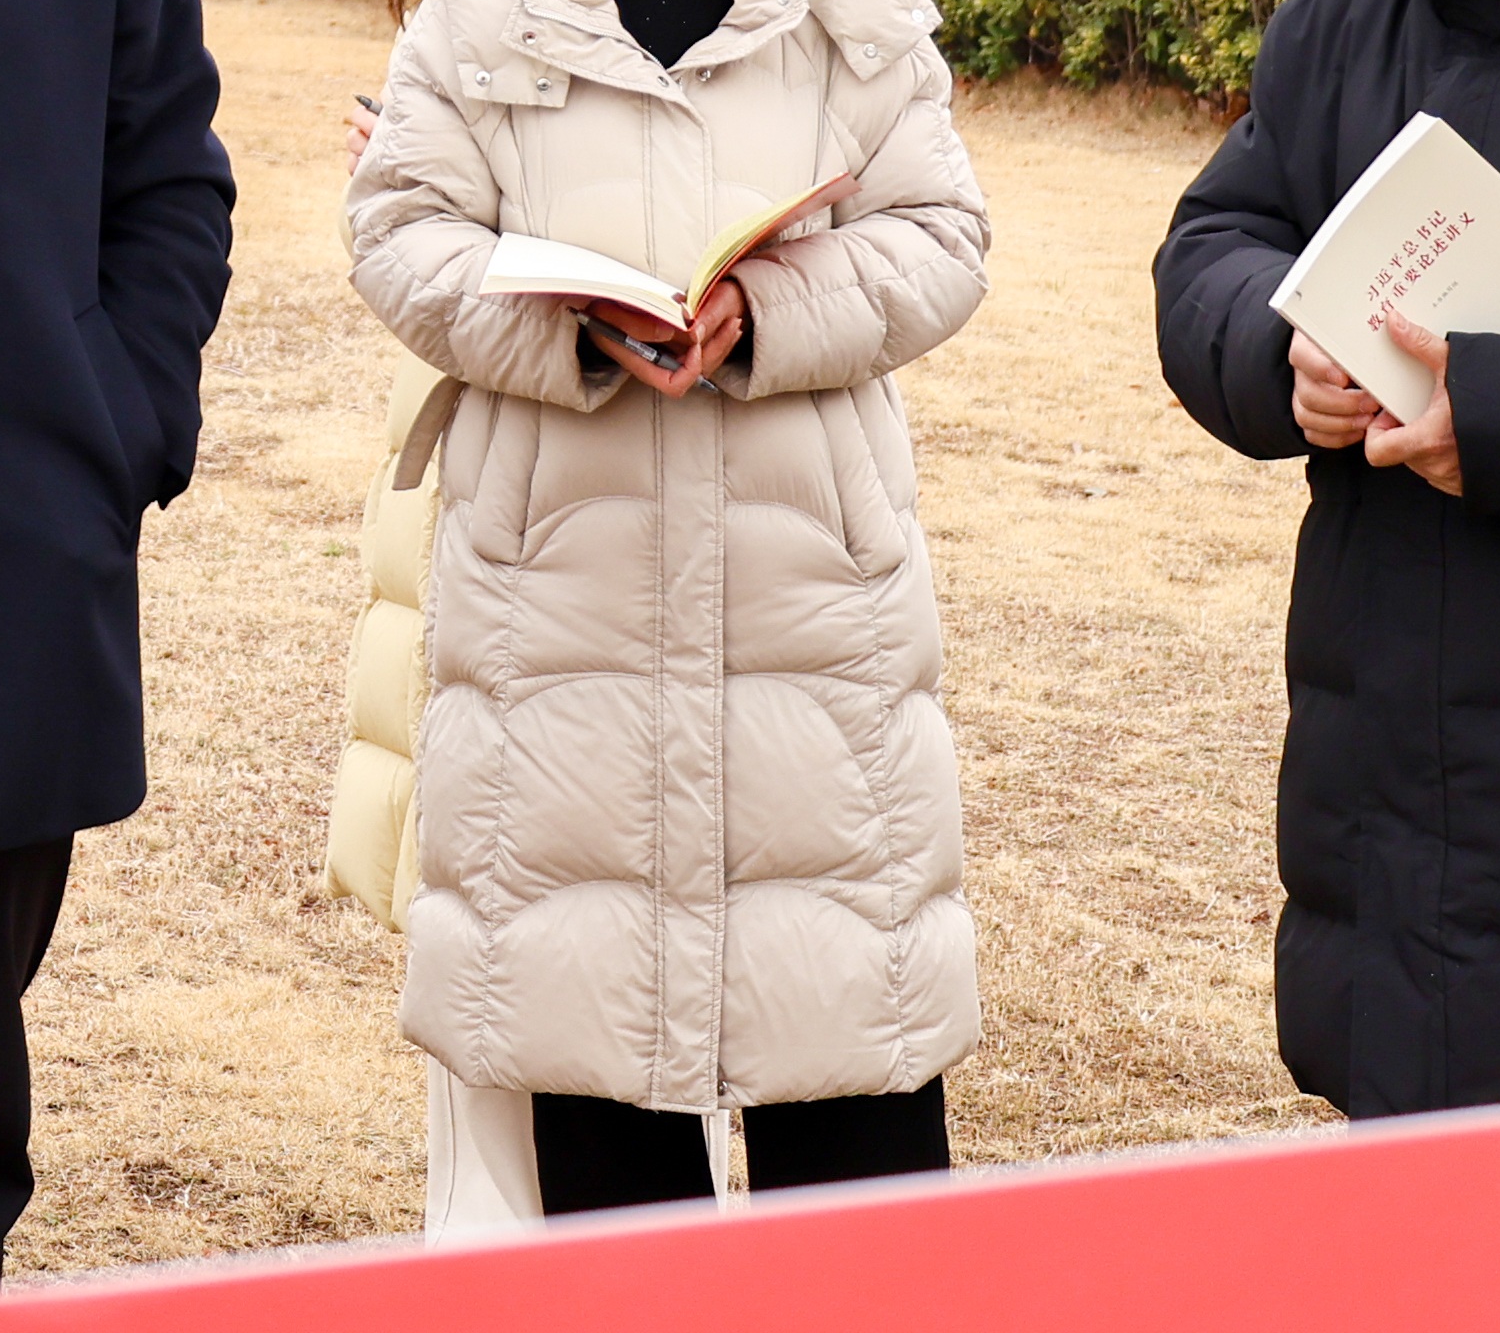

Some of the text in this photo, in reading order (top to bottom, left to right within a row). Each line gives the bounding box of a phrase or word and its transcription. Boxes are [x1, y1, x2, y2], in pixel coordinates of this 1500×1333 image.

[1367, 212, 1475, 332] 教育重要论述讲义
[1368, 210, 1447, 301] 习近平总书记
